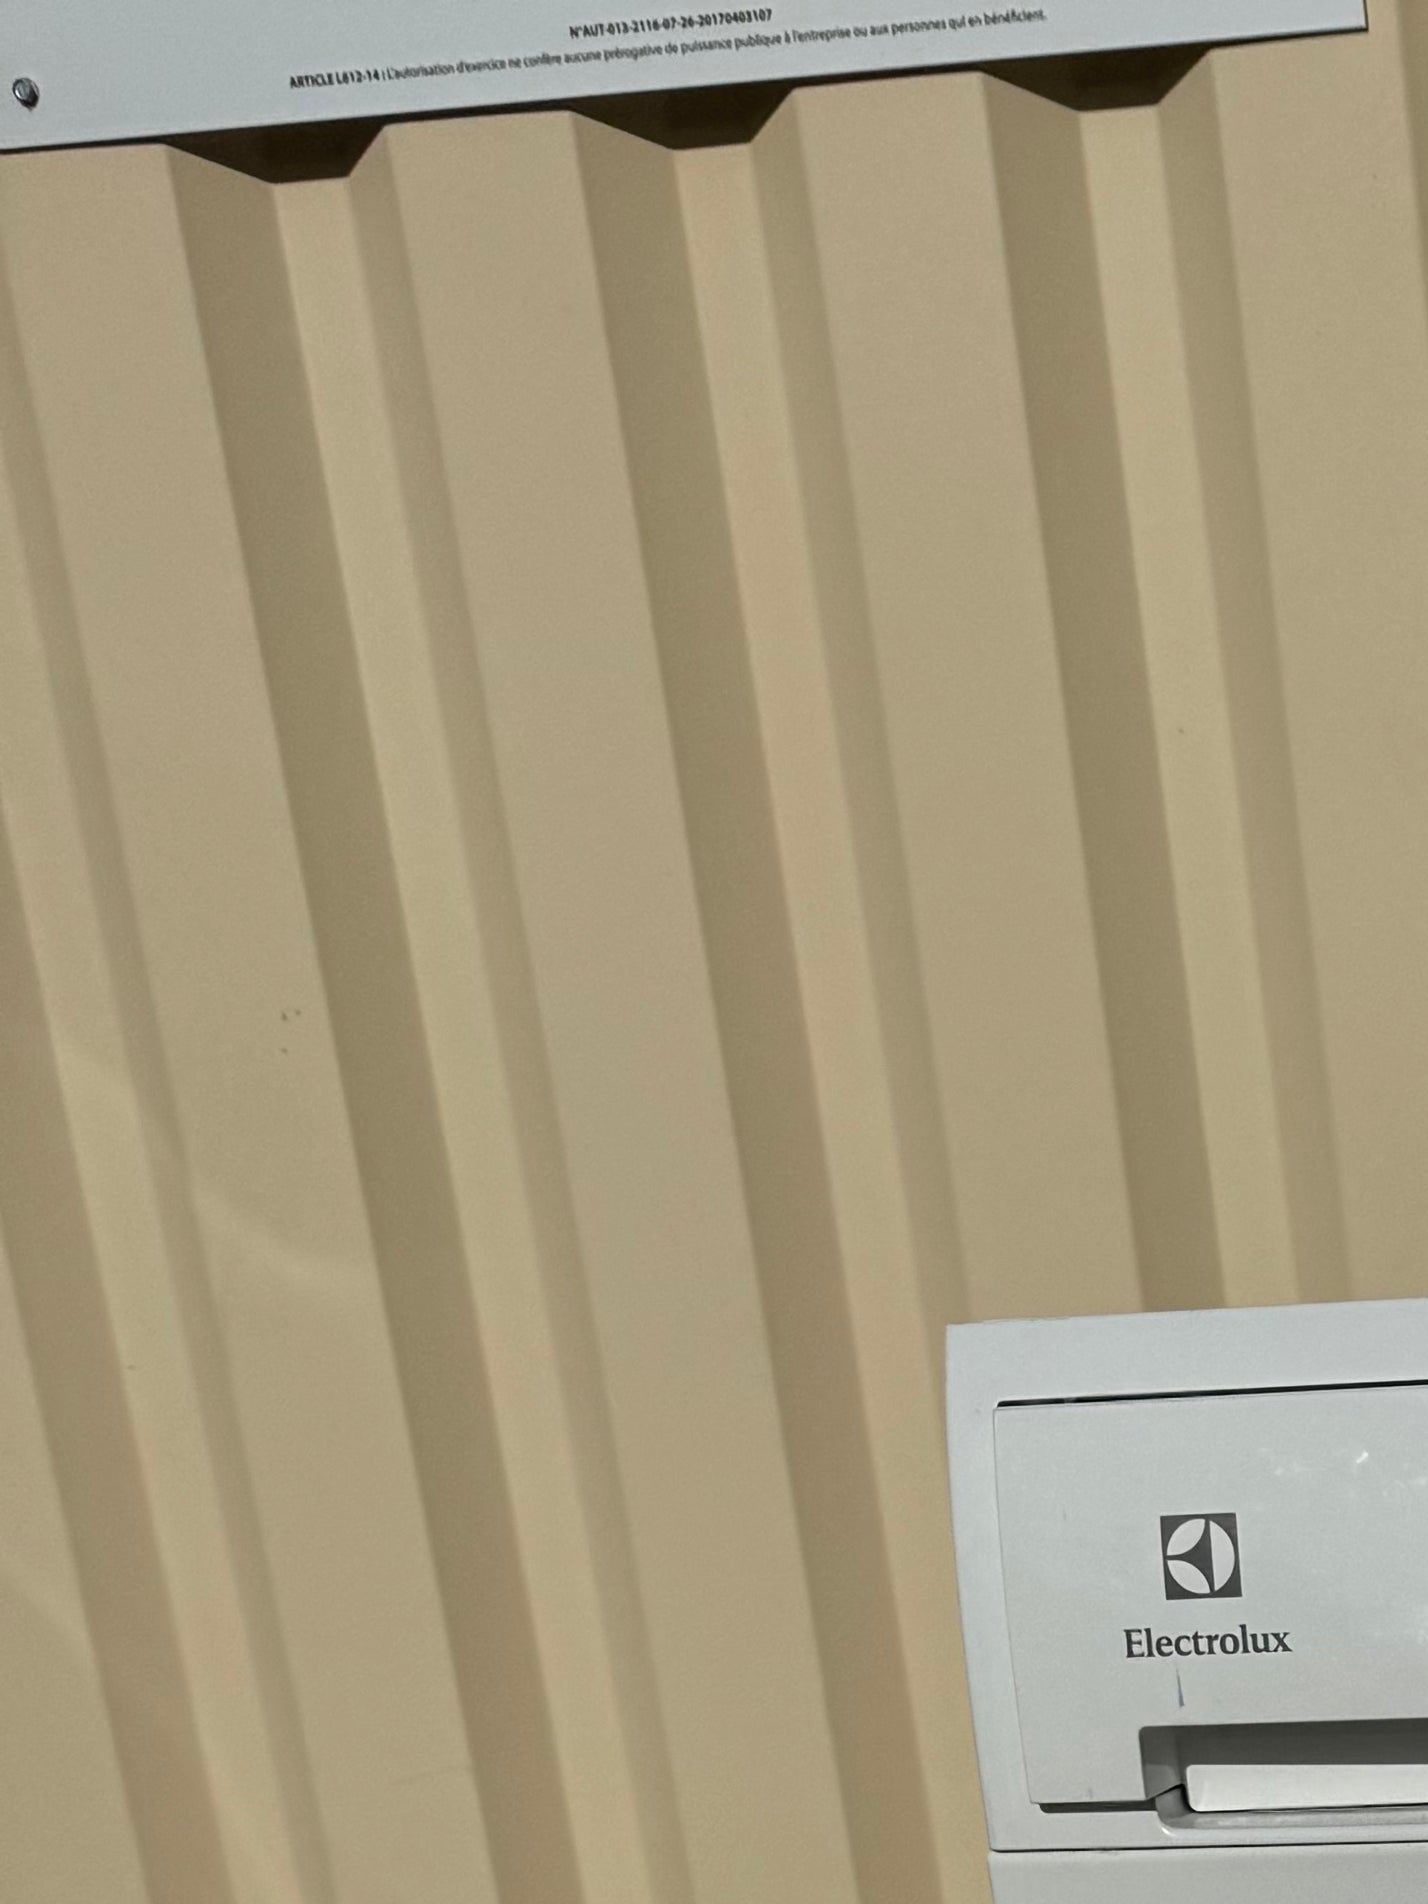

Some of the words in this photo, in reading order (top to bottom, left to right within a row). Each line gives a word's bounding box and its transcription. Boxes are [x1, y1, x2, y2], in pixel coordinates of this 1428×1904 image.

[289, 71, 334, 89] ARTICLE
[564, 49, 602, 64] aucune
[665, 41, 678, 54] de
[680, 36, 732, 56] puissance
[734, 33, 782, 51] publique
[869, 24, 889, 36] aux
[891, 18, 947, 37] personnes
[949, 15, 966, 31] qui
[967, 16, 982, 28] en
[1123, 1623, 1293, 1659] Electrolux
